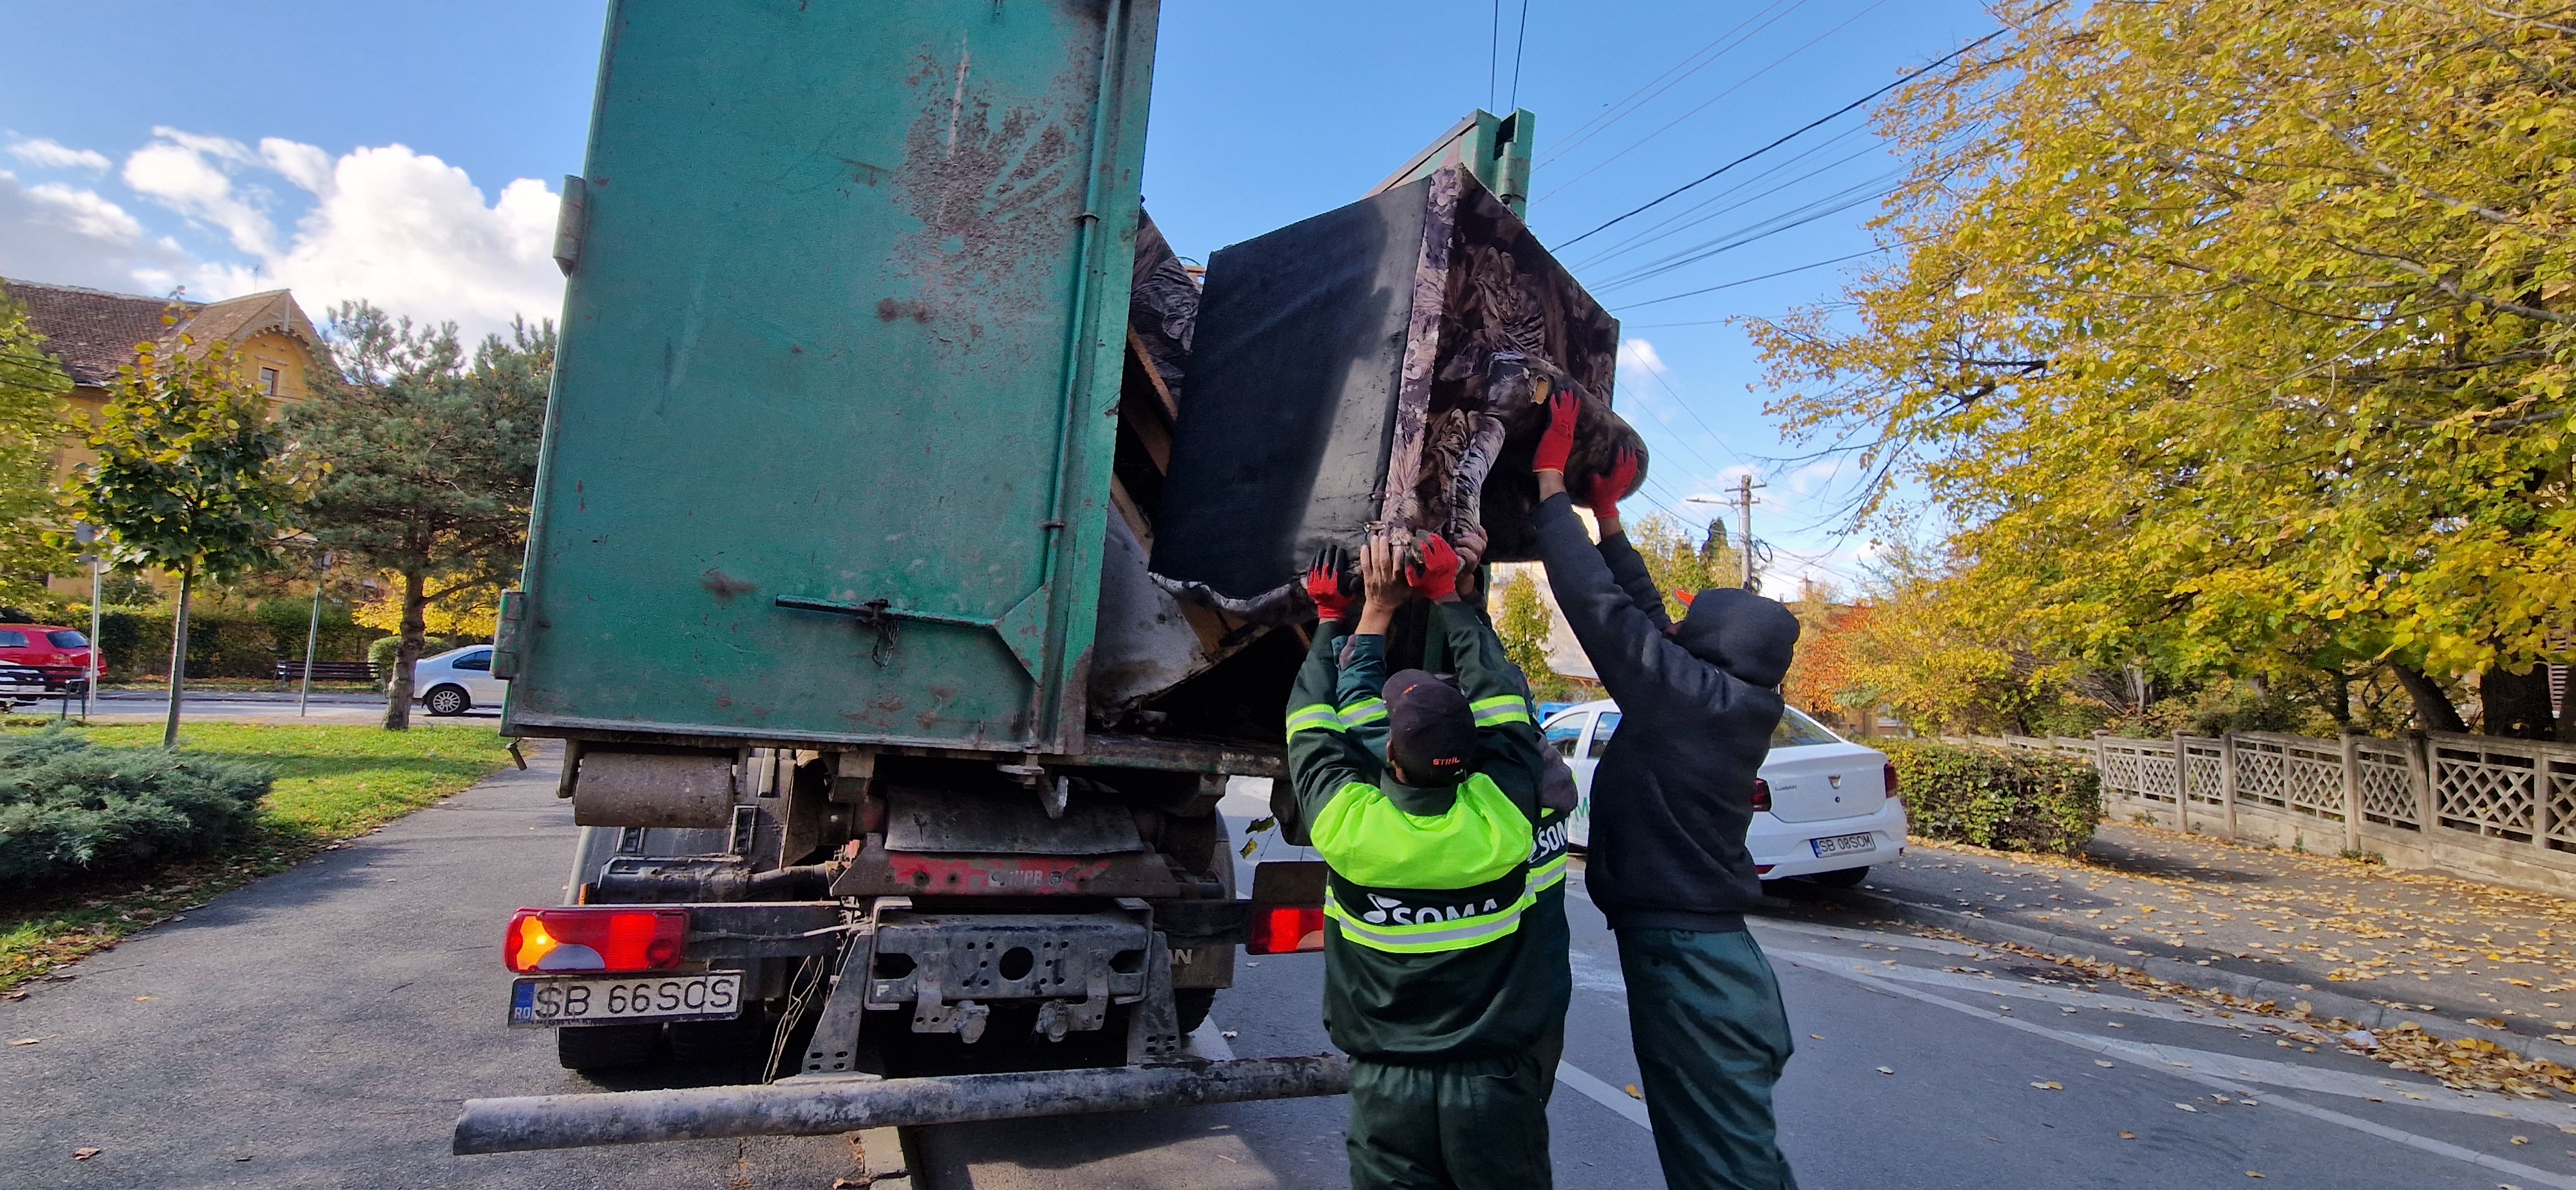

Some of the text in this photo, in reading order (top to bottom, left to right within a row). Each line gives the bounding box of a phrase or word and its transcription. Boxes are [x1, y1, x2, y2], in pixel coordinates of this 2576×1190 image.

[1433, 757, 1461, 765] STIHL
[1819, 840, 1835, 852] SB
[535, 986, 591, 1017] SB
[515, 1006, 531, 1019] RO
